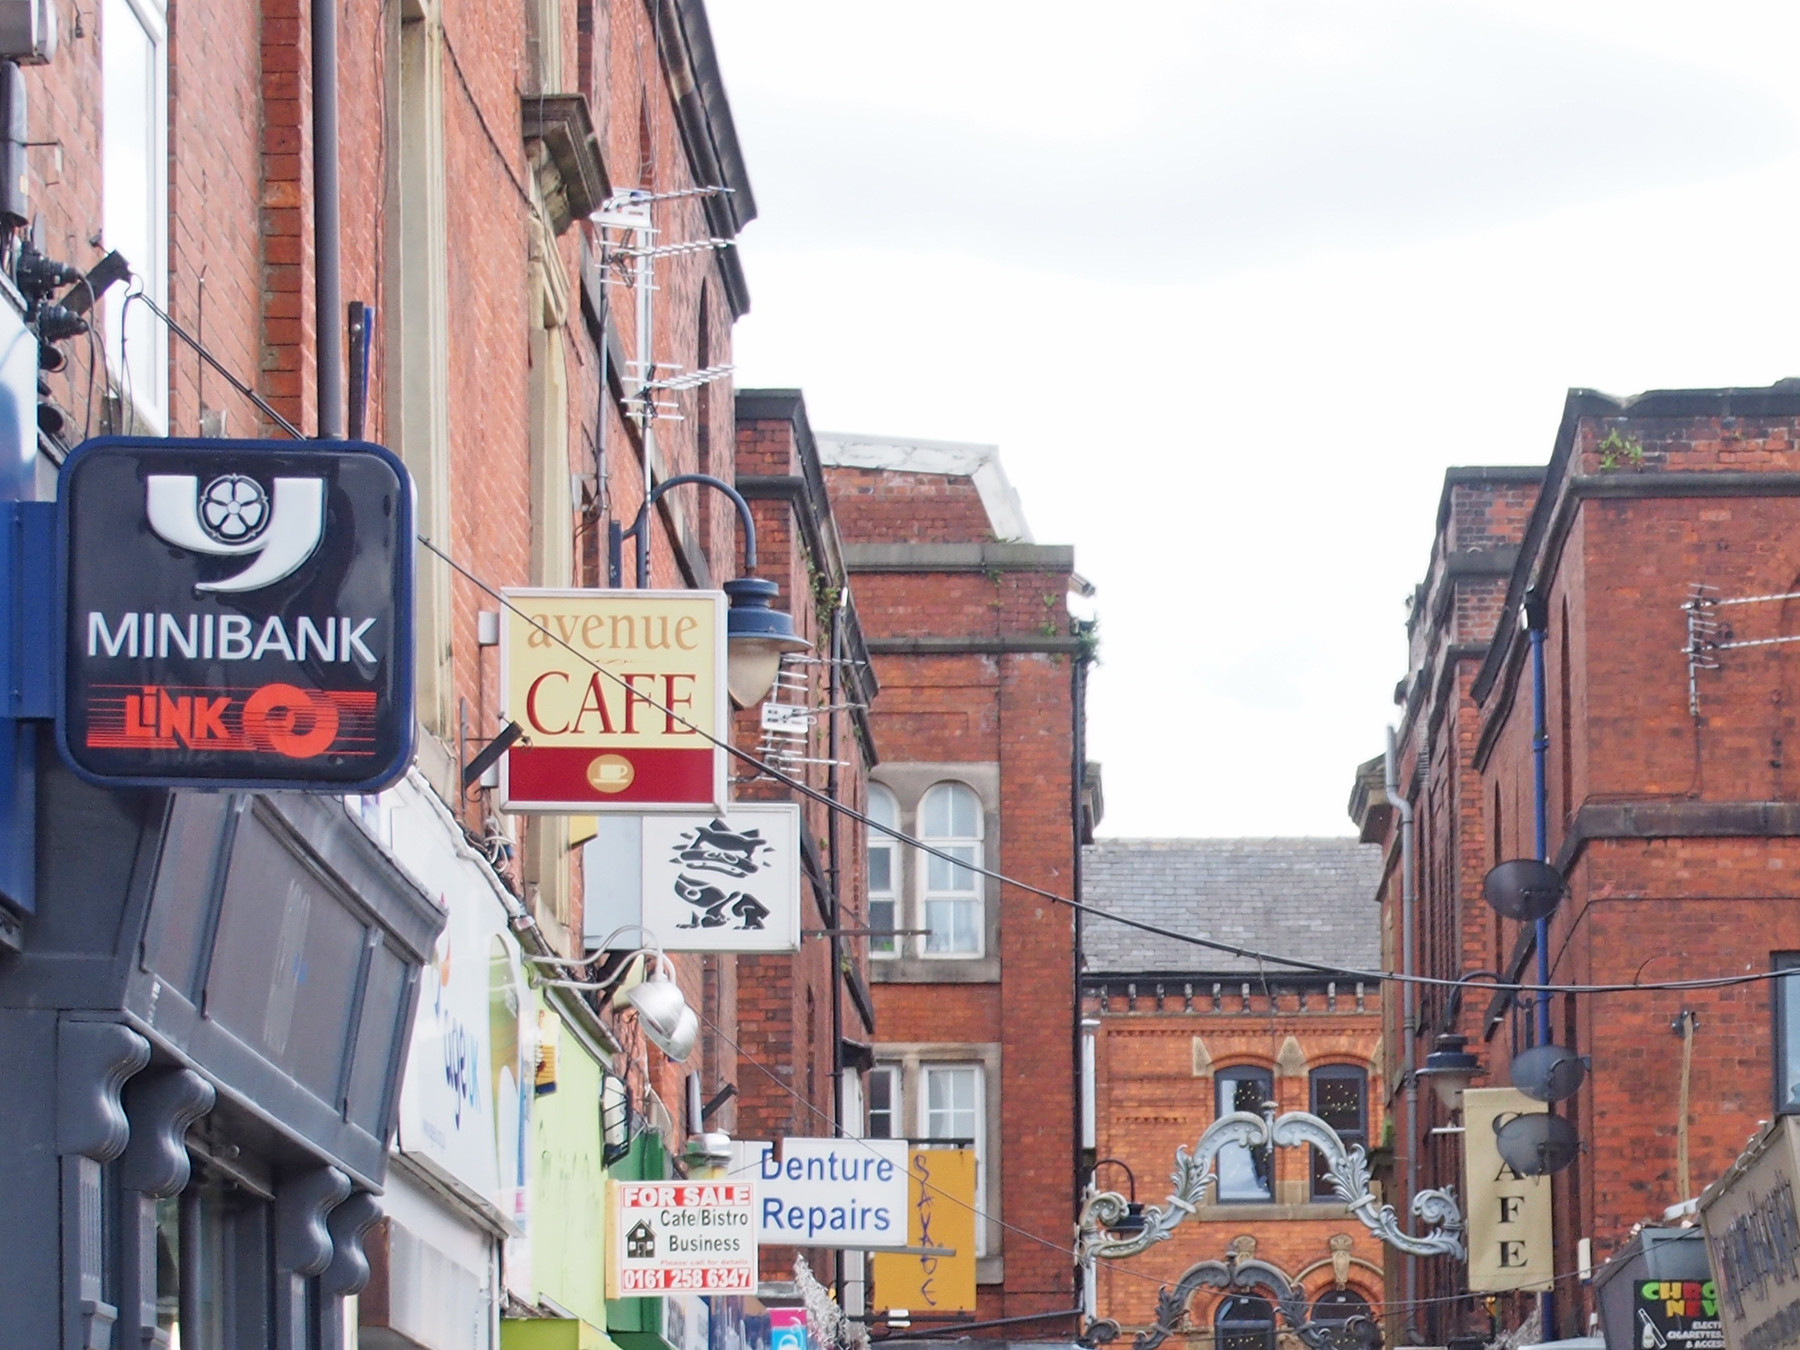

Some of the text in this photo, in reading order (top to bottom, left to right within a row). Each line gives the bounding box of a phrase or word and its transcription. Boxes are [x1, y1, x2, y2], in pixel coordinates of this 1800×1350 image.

[87, 611, 378, 663] MINIBANK
[527, 612, 698, 651] avenue
[526, 670, 698, 736] CAFE
[761, 1148, 894, 1182] Denture
[624, 1186, 750, 1207] FOR SALE
[762, 1197, 891, 1238] Repairs
[669, 1234, 741, 1252] Business
[623, 1268, 750, 1290] 0161 258 6347
